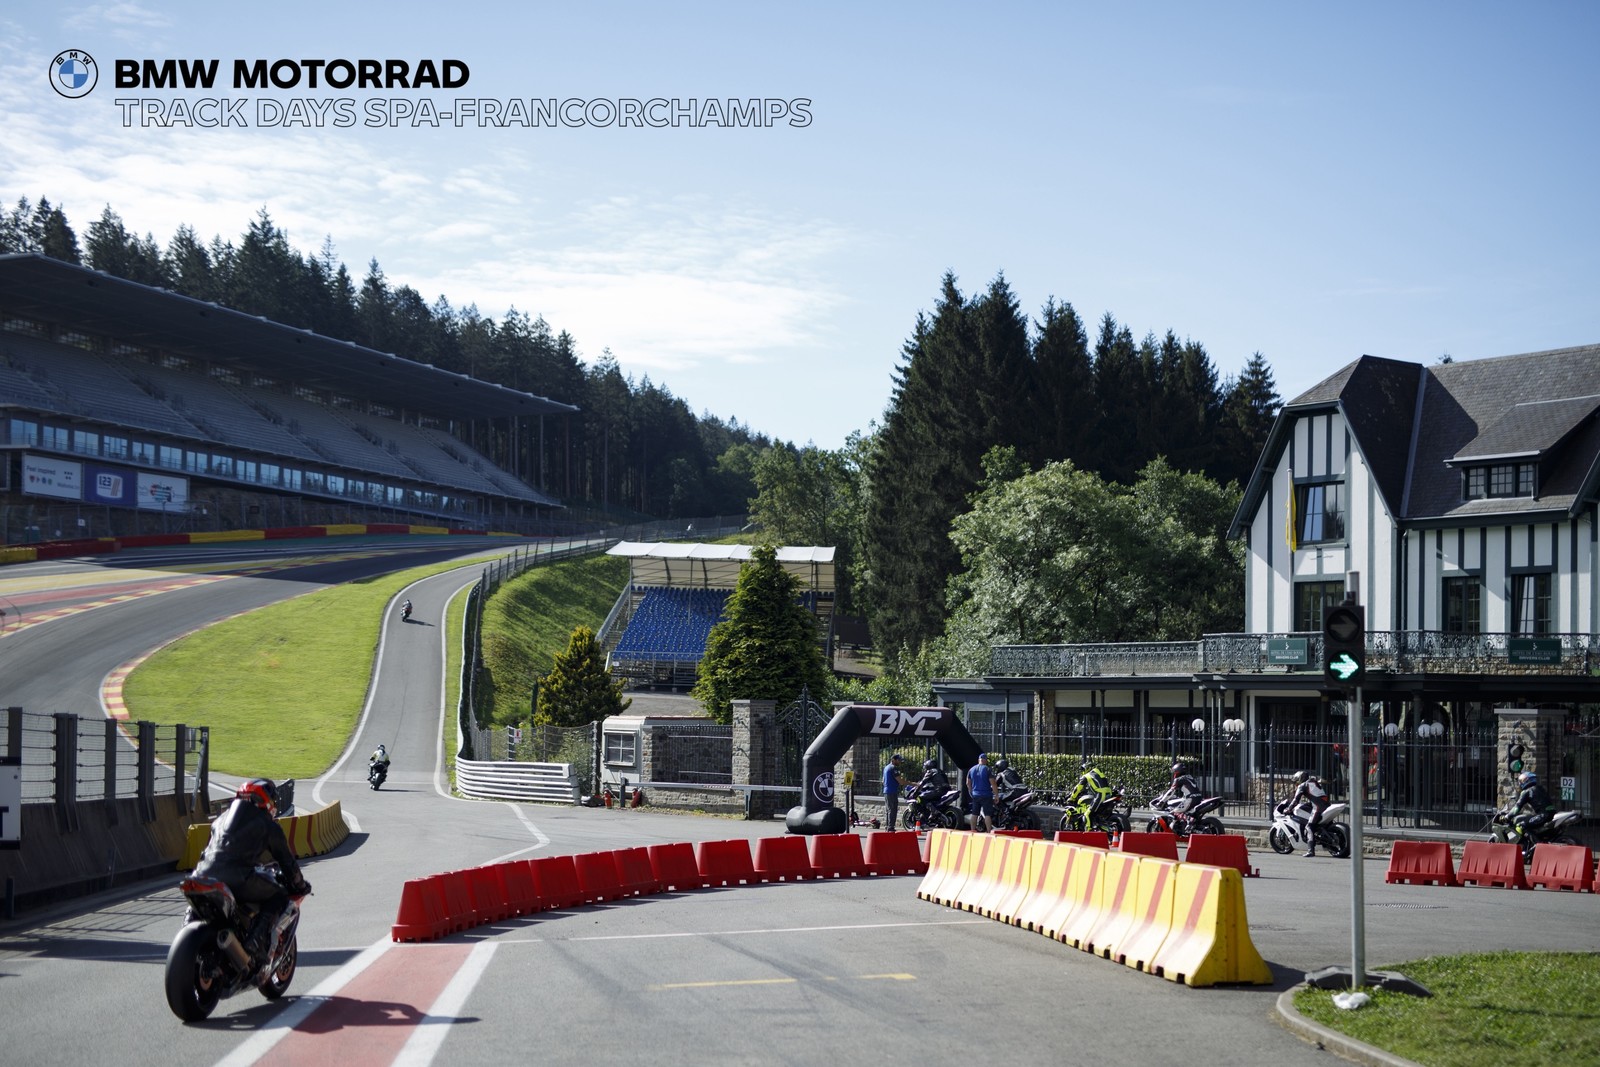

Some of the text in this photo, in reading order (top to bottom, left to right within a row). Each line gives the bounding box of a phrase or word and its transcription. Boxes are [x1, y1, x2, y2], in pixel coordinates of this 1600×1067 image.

[99, 475, 111, 486] 123
[870, 709, 942, 736] BMC
[1563, 778, 1573, 786] D2
